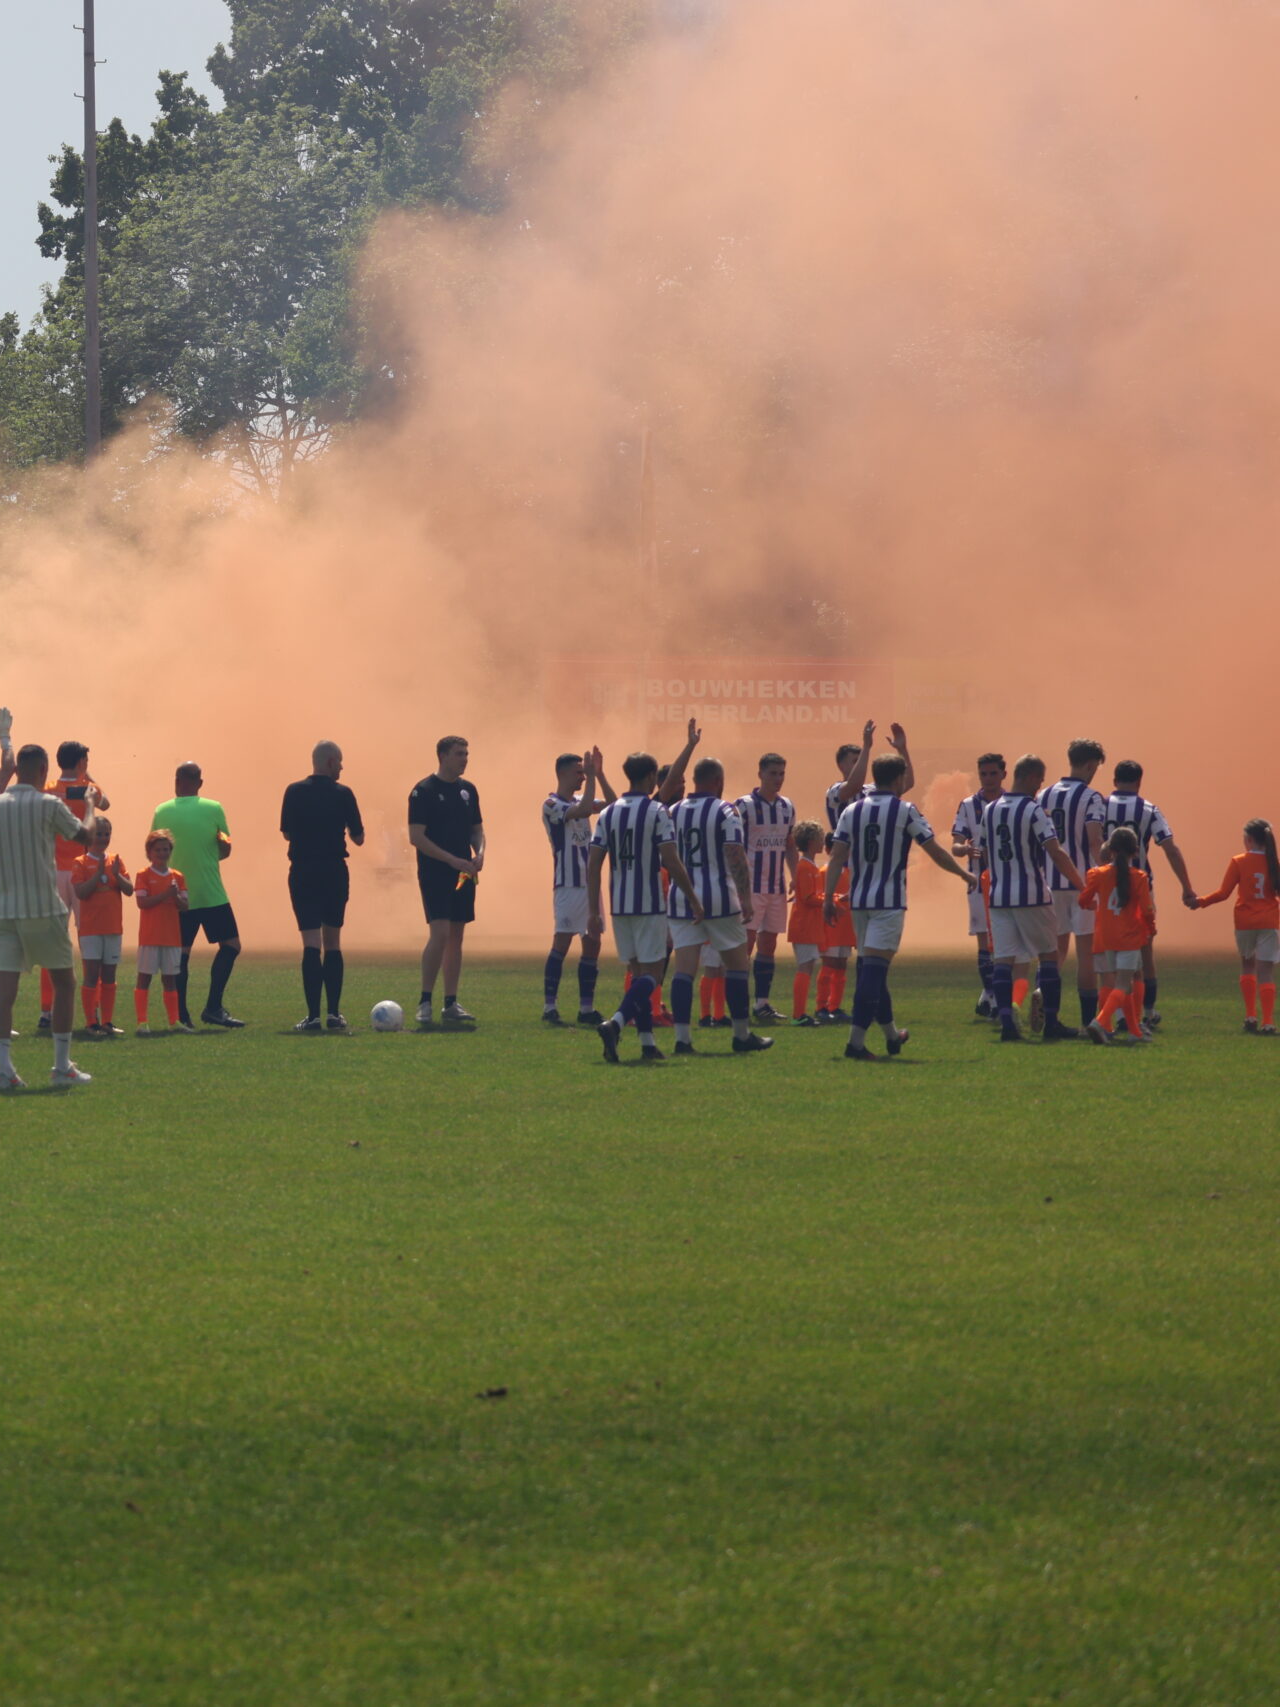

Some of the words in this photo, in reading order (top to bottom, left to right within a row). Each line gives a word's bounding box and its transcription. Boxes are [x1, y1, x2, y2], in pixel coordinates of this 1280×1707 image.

[646, 679, 856, 699] BOUWHEKKEN
[646, 704, 856, 723] NEDERLAND.NL
[610, 828, 635, 871] 14
[677, 827, 704, 867] 12
[863, 823, 881, 864] 6
[996, 823, 1014, 863] 3
[1253, 872, 1265, 899] 3
